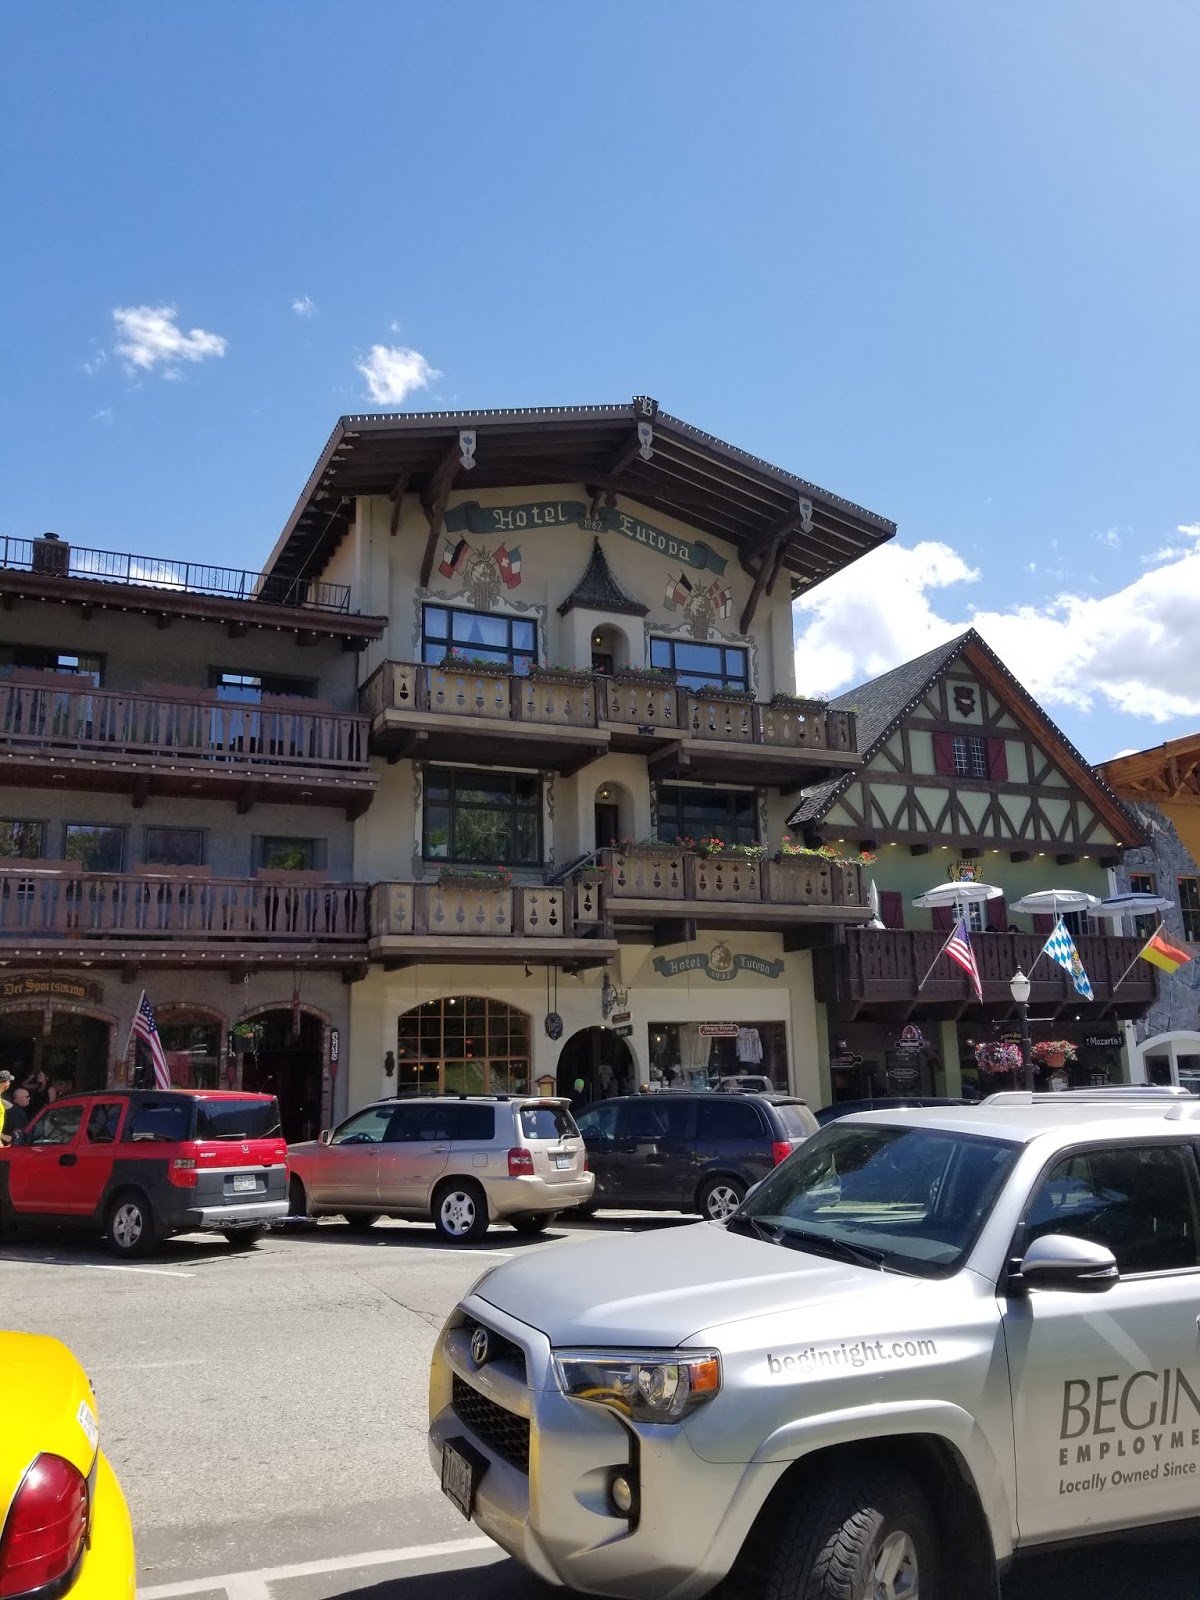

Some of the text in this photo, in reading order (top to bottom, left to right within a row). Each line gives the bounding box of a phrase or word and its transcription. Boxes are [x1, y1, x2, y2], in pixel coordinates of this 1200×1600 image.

[493, 503, 691, 562] Hotel Europa
[583, 518, 603, 532] 1982
[669, 955, 771, 975] Hotel Europa
[3, 978, 86, 998] Der Sportsmann
[1088, 1036, 1119, 1047] Mozart's
[766, 1338, 939, 1375] beginright.com
[1059, 1367, 1200, 1440] BEGIN
[1058, 1428, 1200, 1467] EMPLOYME
[1058, 1460, 1197, 1495] Locally Owned Since
